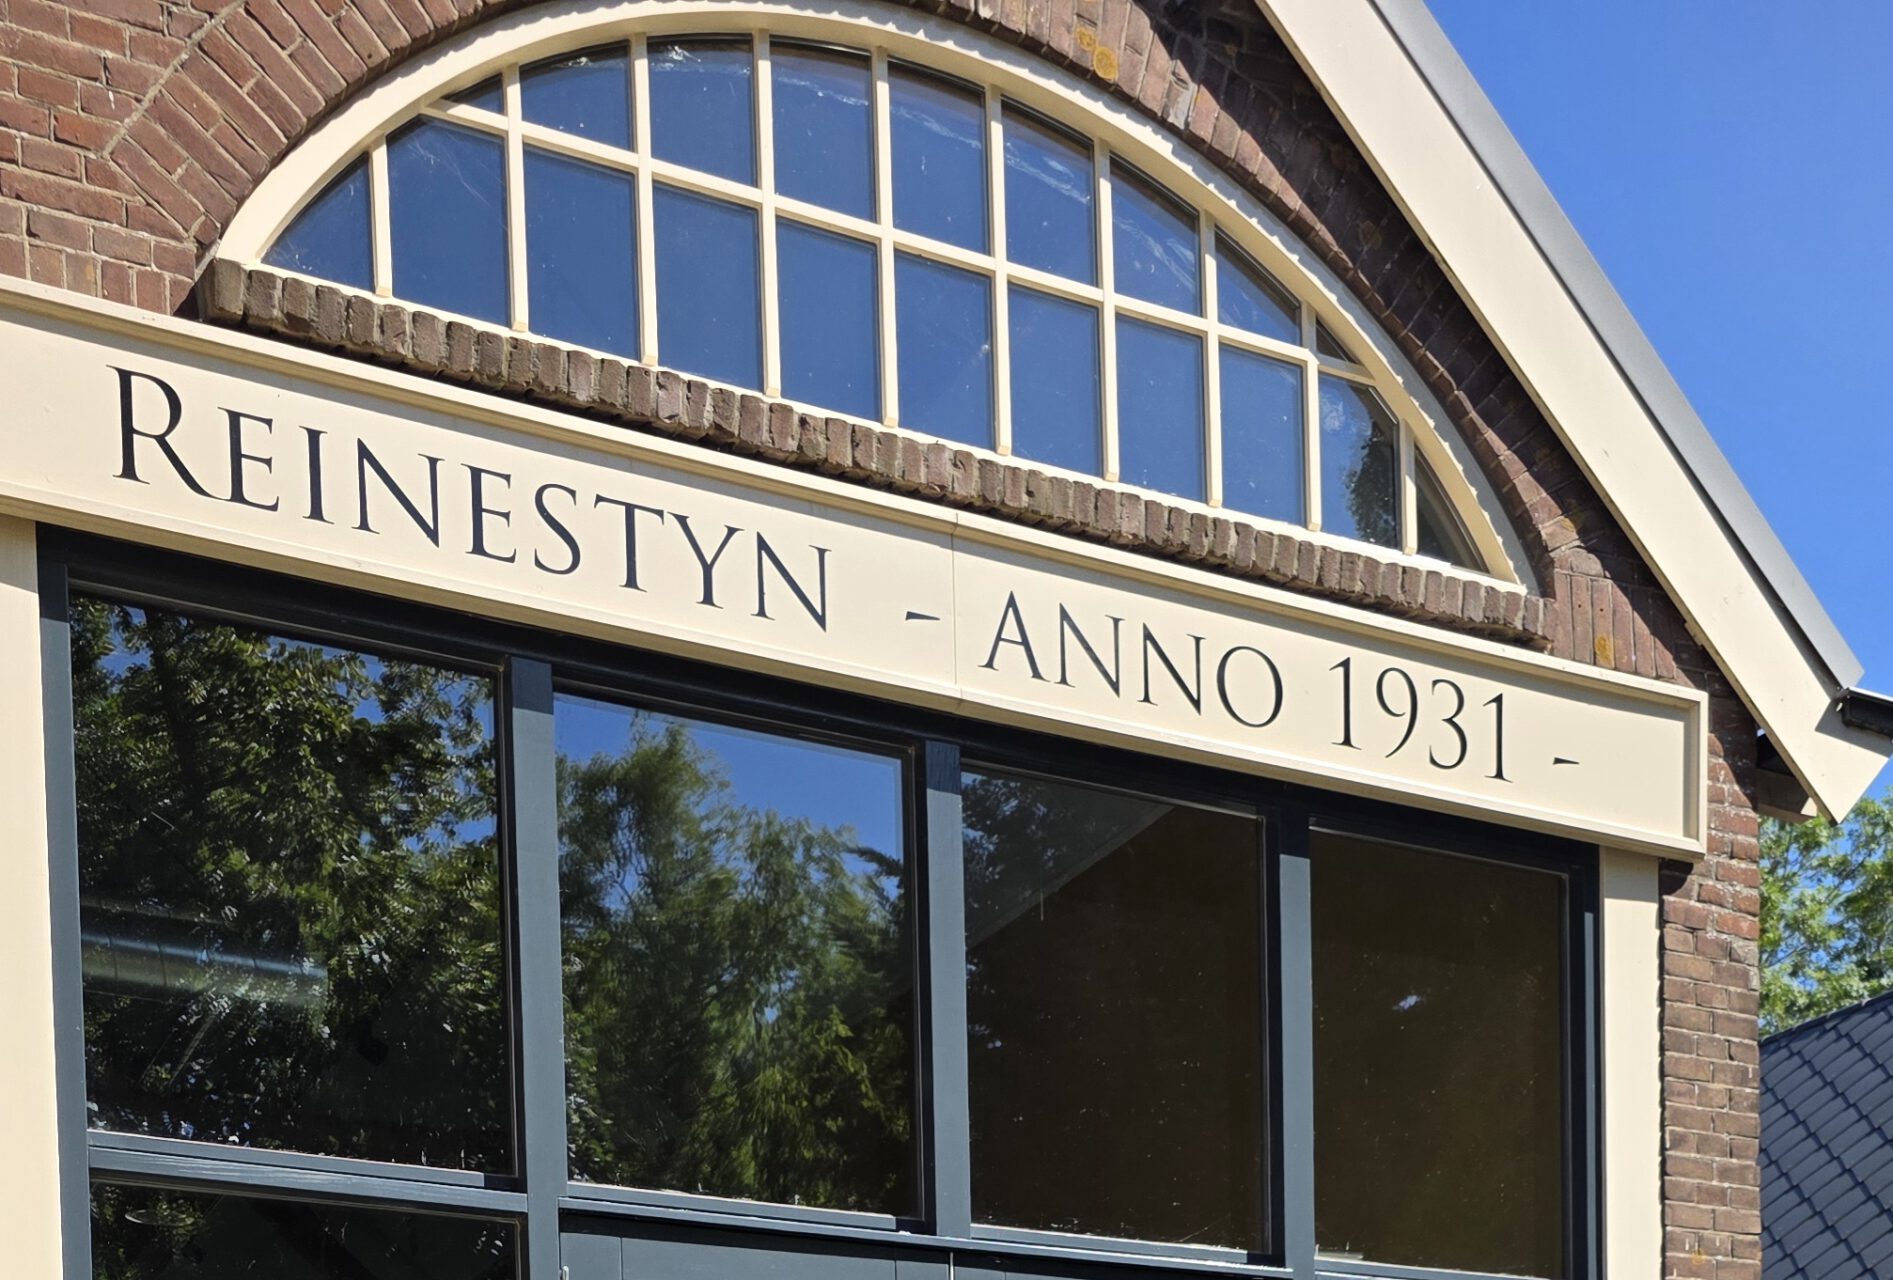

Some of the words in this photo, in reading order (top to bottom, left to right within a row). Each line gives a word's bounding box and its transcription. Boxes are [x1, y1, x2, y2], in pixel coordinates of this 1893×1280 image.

[107, 365, 831, 632] REINESTYN
[978, 590, 1283, 728] ANNO
[1329, 657, 1513, 783] 1931
